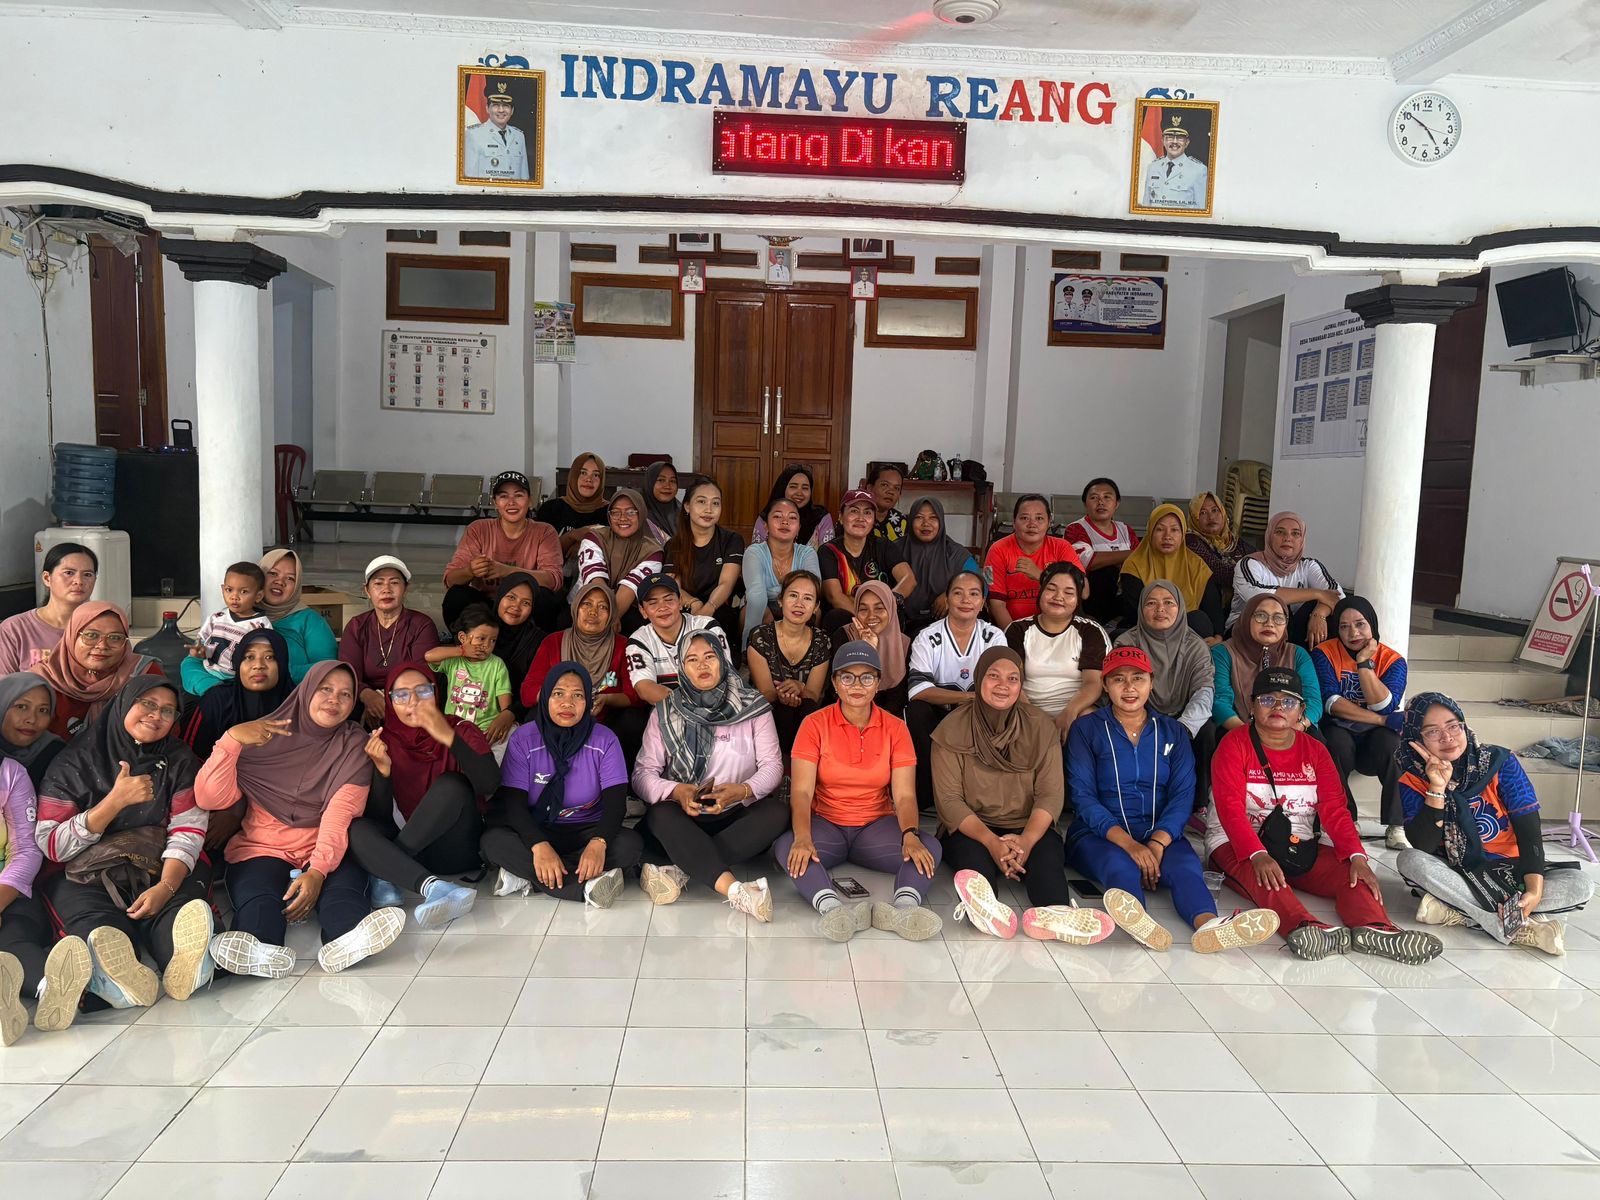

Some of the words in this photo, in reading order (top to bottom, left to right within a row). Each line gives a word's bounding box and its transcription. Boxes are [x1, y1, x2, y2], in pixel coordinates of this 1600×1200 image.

[560, 54, 898, 115] INDRAMAYU
[925, 75, 1117, 125] REANG
[1412, 103, 1420, 111] 11
[1423, 100, 1433, 108] 12
[1438, 103, 1442, 112] 1
[1403, 111, 1412, 120] 10
[1446, 112, 1451, 121] 2
[1399, 124, 1406, 133] 9
[1447, 125, 1453, 134] 3
[1402, 137, 1408, 145] 8
[1443, 137, 1449, 146] 4
[840, 128, 873, 164] Di
[884, 127, 953, 167] kan
[1411, 146, 1417, 155] 7
[1434, 146, 1440, 155] 5
[1421, 149, 1428, 158] 6
